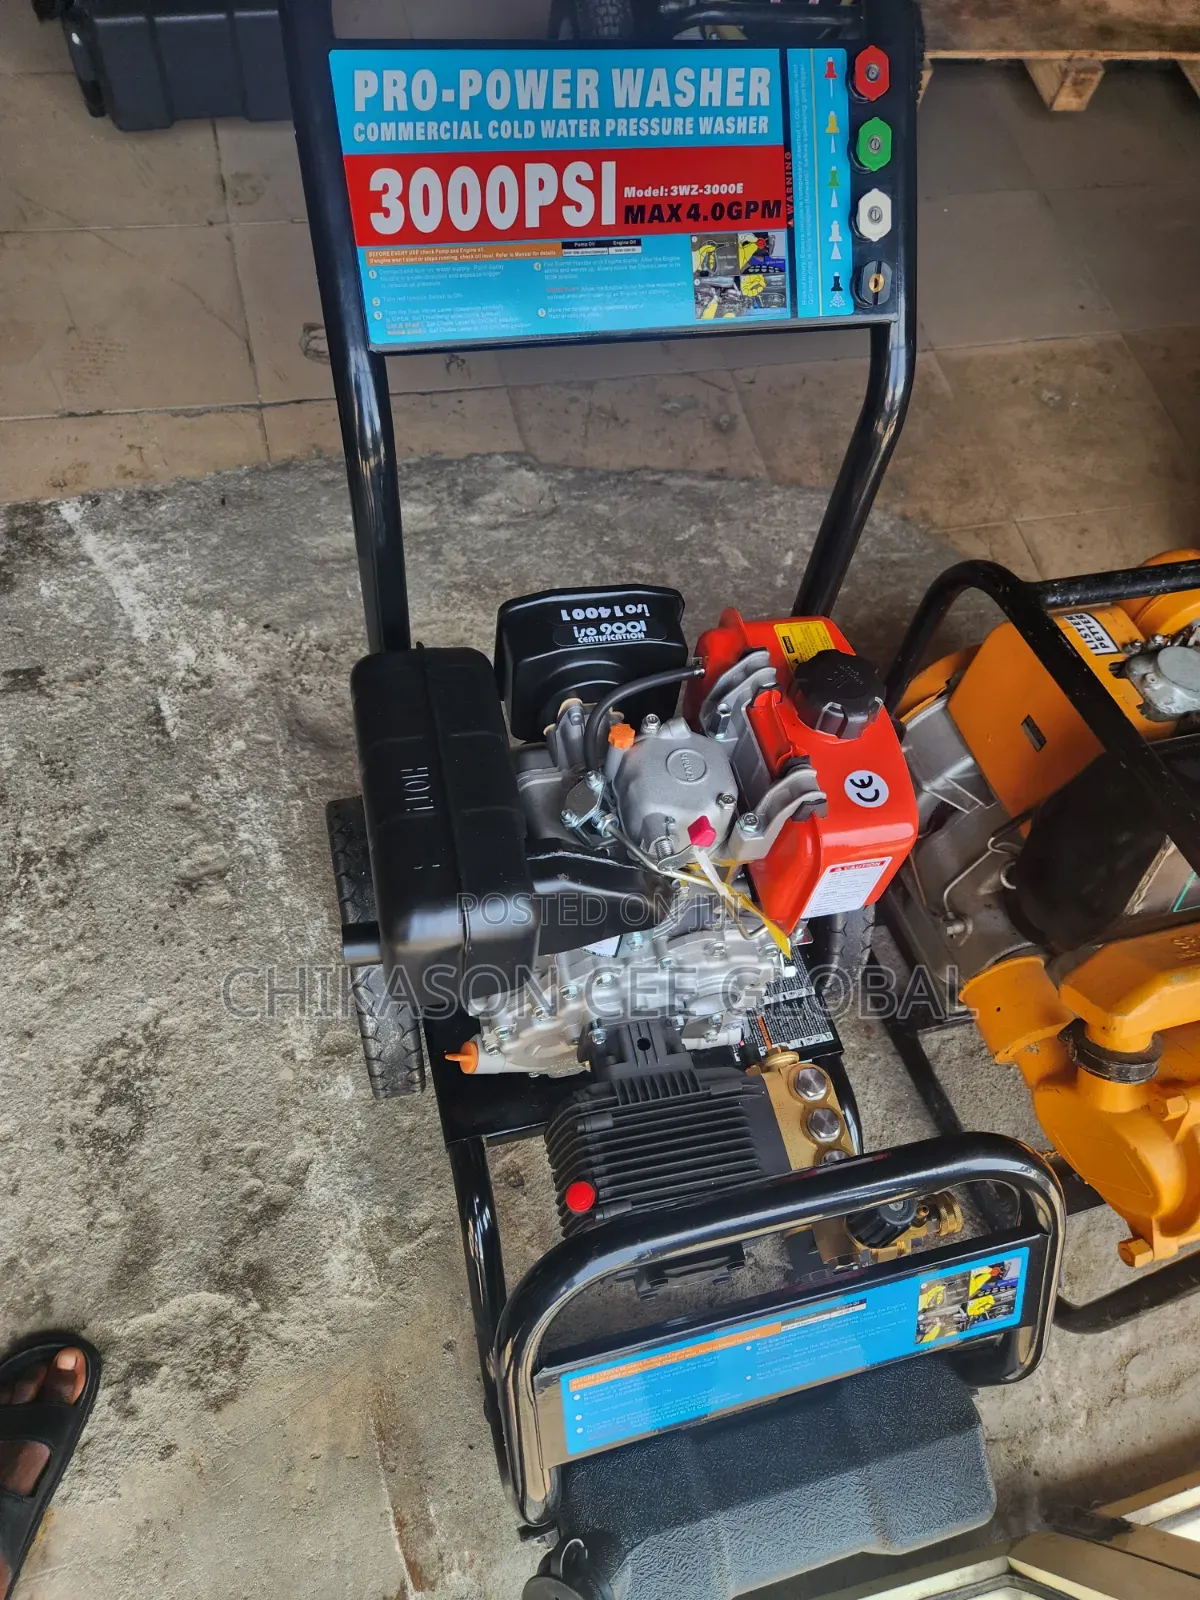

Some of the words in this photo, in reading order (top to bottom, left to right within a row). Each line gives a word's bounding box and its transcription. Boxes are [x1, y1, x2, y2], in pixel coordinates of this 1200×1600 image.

[354, 68, 599, 112] PRO-POWER
[611, 67, 770, 108] WASHER
[353, 120, 483, 142] COMMERCIAL
[488, 120, 535, 139] COLD
[541, 118, 600, 138] WATER
[605, 116, 694, 137] PRESSURE
[700, 115, 769, 134] WASHER
[624, 186, 668, 198] Model:
[670, 182, 744, 196] 3WZ-3000E
[784, 151, 794, 214] WARNING
[369, 160, 616, 235] 3000PSI
[560, 605, 624, 621] 14001
[578, 632, 645, 644] CERTIFICATION
[600, 620, 647, 634] 9001
[1065, 616, 1100, 650] LISTER
[1075, 614, 1110, 649] PETTER
[849, 776, 880, 802] CE
[844, 861, 881, 870] CAUTION
